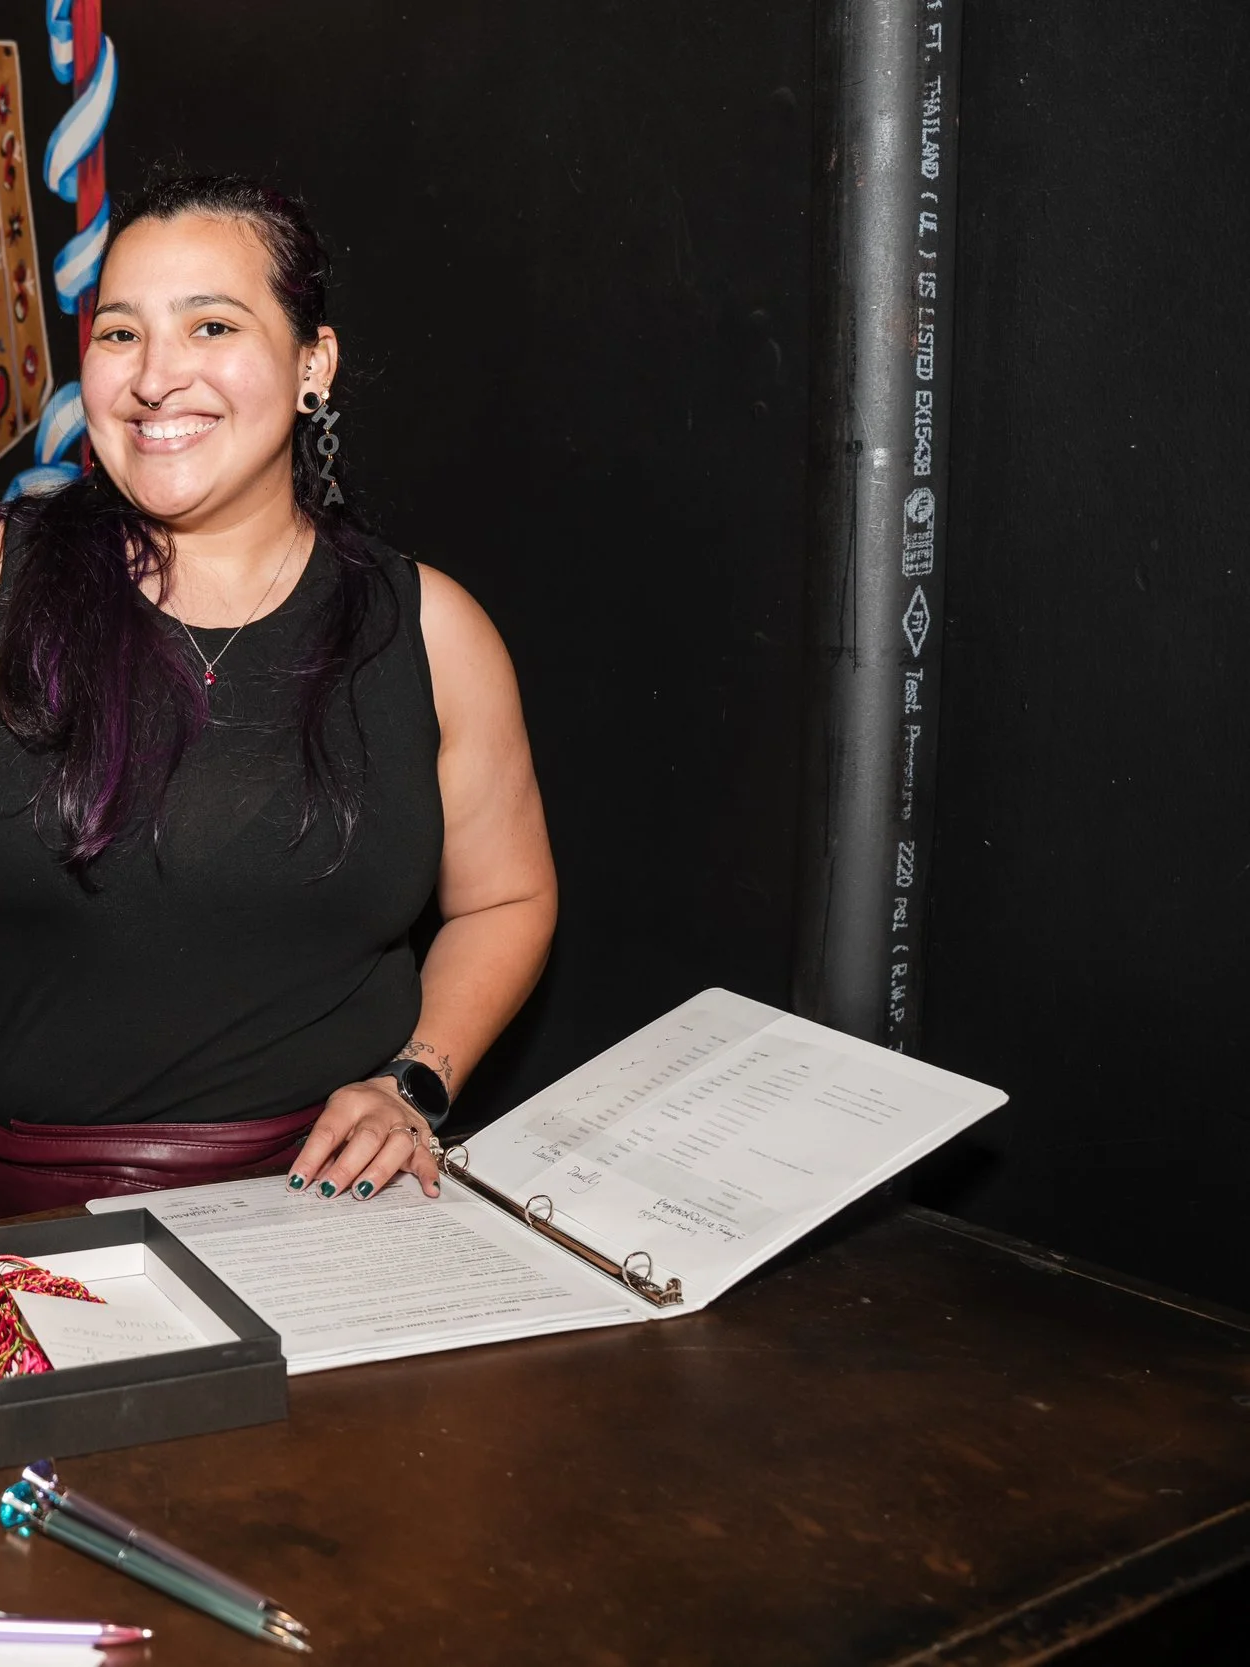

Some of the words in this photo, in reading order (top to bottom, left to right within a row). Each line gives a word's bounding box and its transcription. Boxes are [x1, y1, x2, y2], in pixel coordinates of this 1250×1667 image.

[920, 75, 941, 180] THAILAND
[918, 211, 938, 238] UL
[918, 271, 937, 299] US
[915, 306, 936, 381] LISTED
[311, 403, 345, 507] HOLA
[903, 667, 924, 715] Test
[895, 840, 916, 888] 2220
